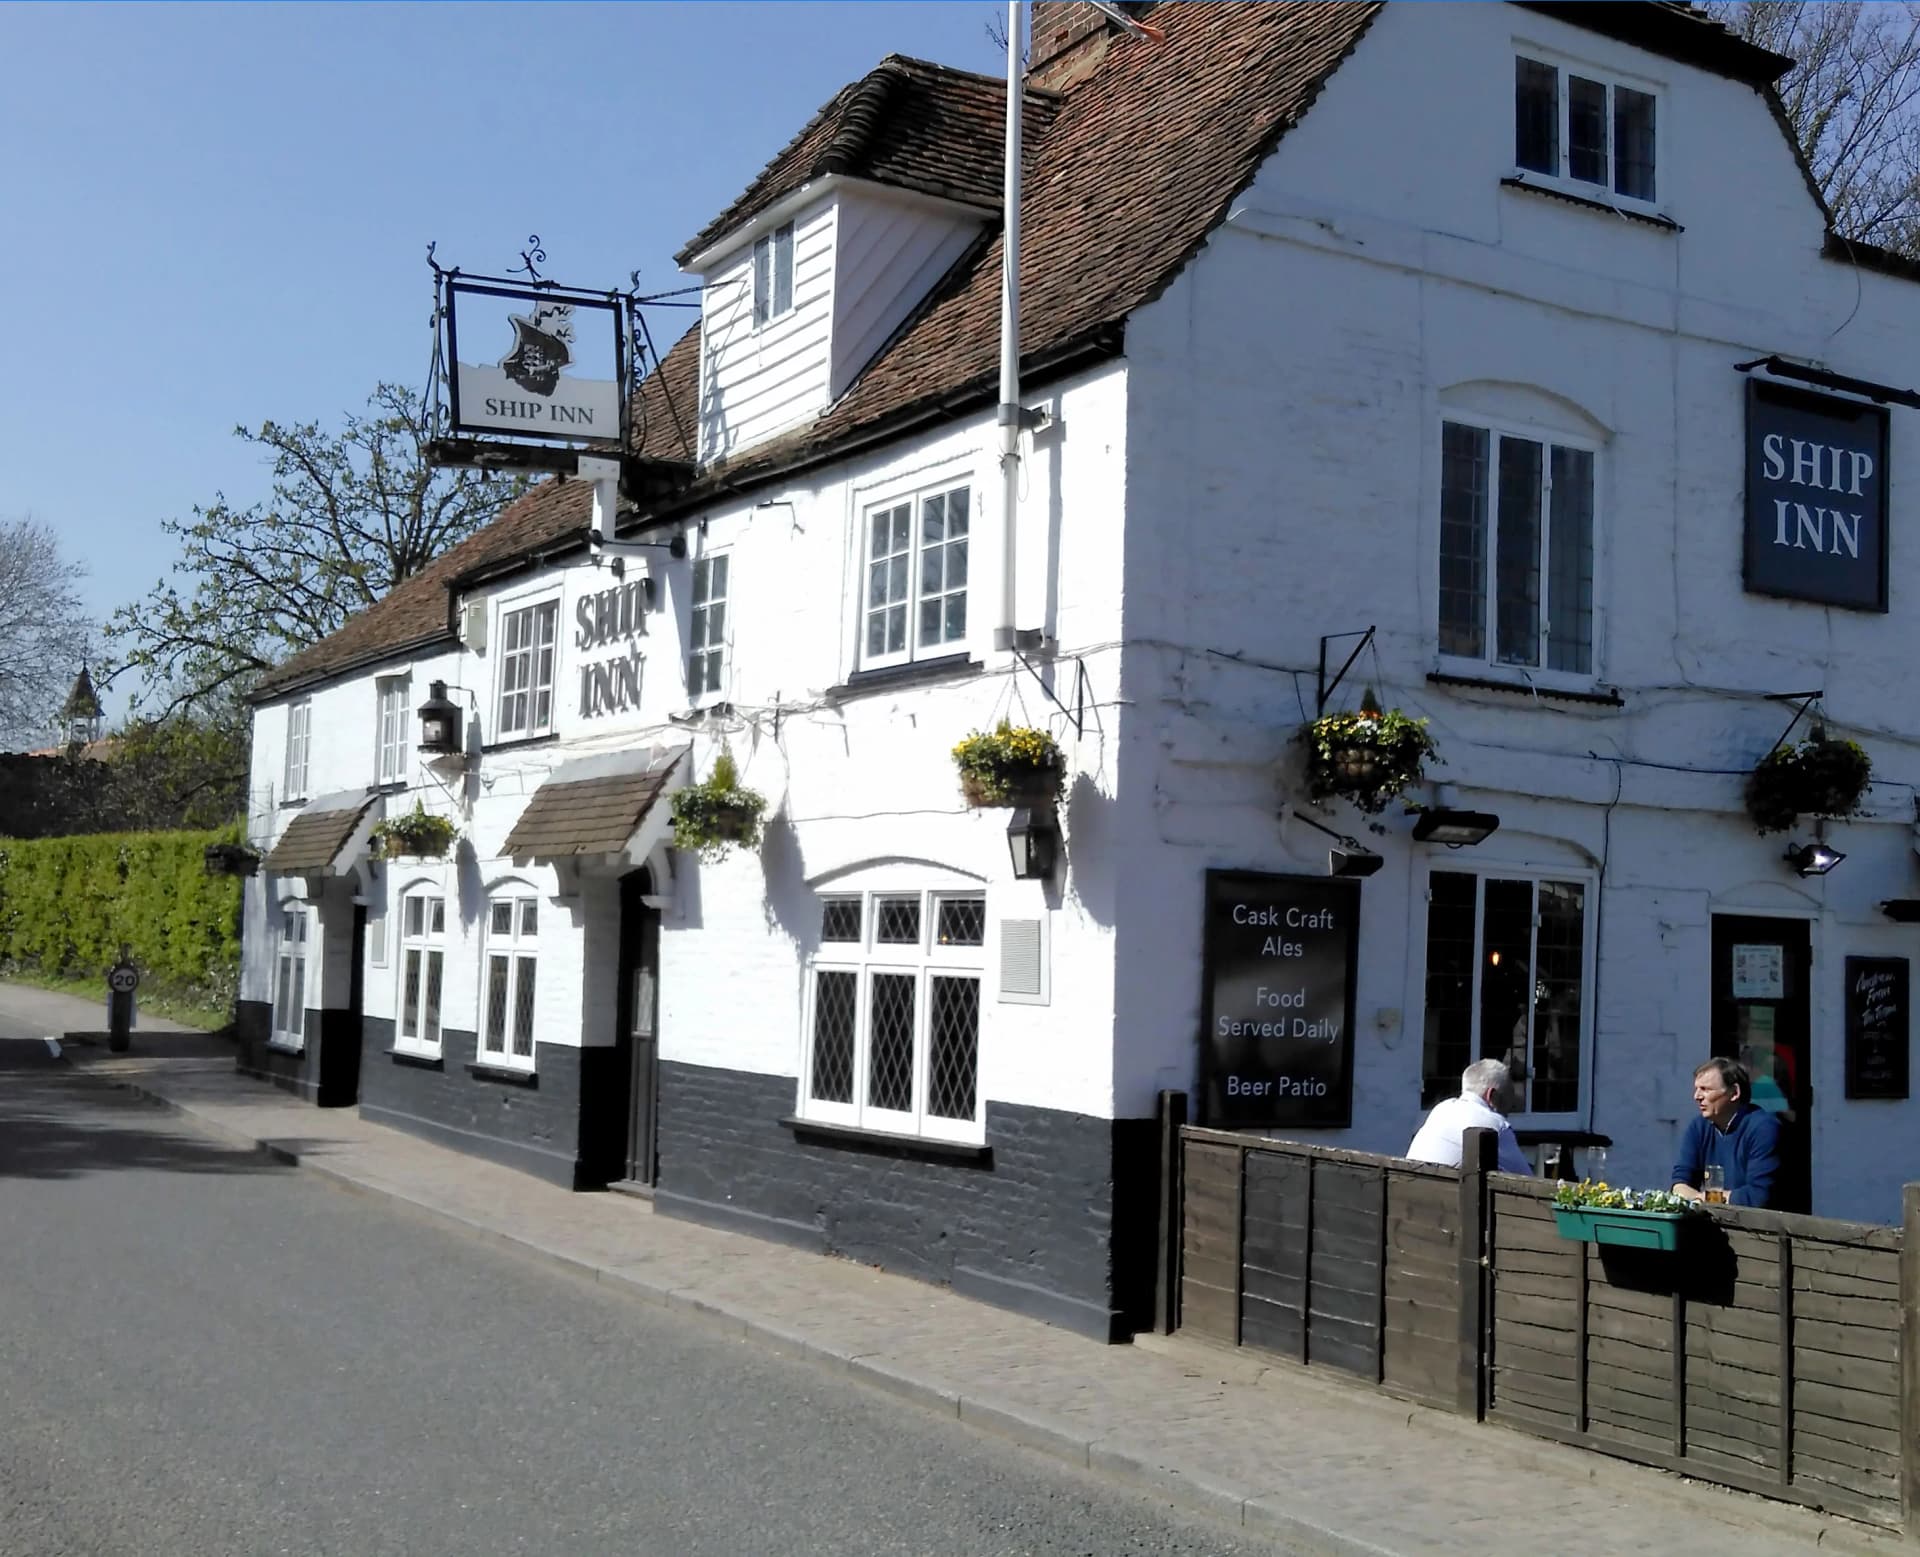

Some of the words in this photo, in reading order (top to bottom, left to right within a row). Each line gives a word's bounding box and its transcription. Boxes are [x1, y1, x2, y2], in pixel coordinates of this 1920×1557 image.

[485, 398, 542, 421] SHIP
[551, 404, 594, 425] INN
[1763, 433, 1873, 496] SHIP
[1773, 499, 1863, 559] INN
[577, 652, 647, 719] INN
[1232, 903, 1279, 927] Cask
[1285, 907, 1335, 930] Craft
[1261, 936, 1303, 957] Ales
[115, 975, 135, 987] 20
[1256, 986, 1305, 1008] Food
[1218, 1016, 1285, 1038] Served
[1292, 1017, 1339, 1045] Daily
[1227, 1075, 1272, 1096] Beer
[1279, 1076, 1327, 1097] Patio
